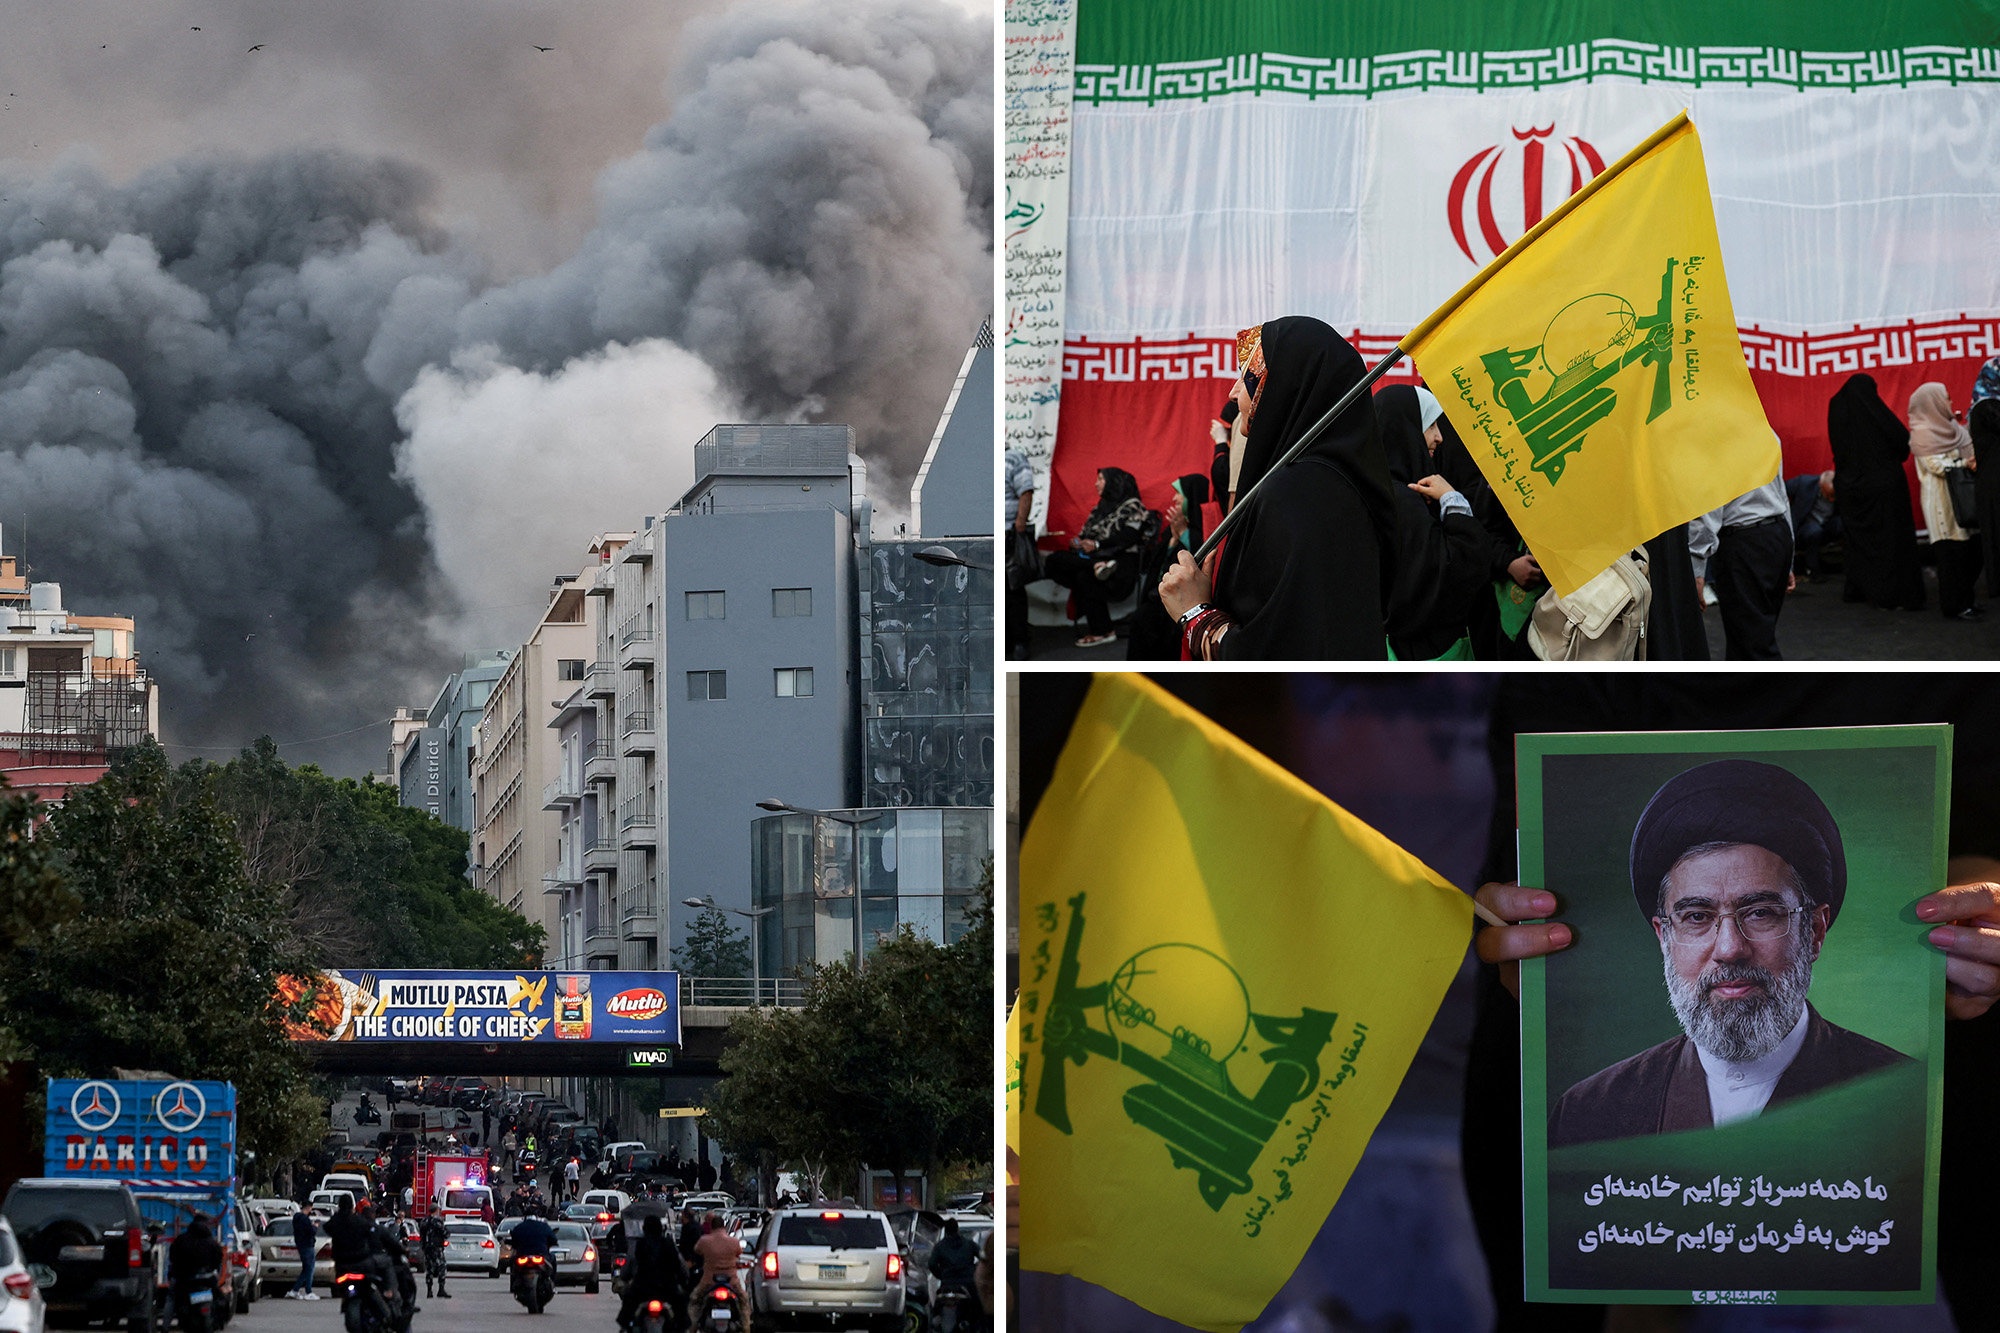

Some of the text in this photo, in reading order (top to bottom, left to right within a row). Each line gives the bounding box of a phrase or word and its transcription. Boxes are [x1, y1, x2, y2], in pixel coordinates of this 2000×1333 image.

[427, 740, 439, 796] District
[391, 985, 509, 1005] MUTLU PASTA
[354, 1016, 539, 1038] THE CHOICE OF CHEFS
[1683, 1175, 1743, 1207] توایم
[1741, 1174, 1807, 1207] سرباز
[1809, 1177, 1862, 1200] همه
[1863, 1176, 1888, 1201] ما
[1676, 1221, 1736, 1254] توایم
[1738, 1218, 1807, 1254] فرمان
[1808, 1225, 1832, 1250] به
[1835, 1219, 1895, 1255] گوش
